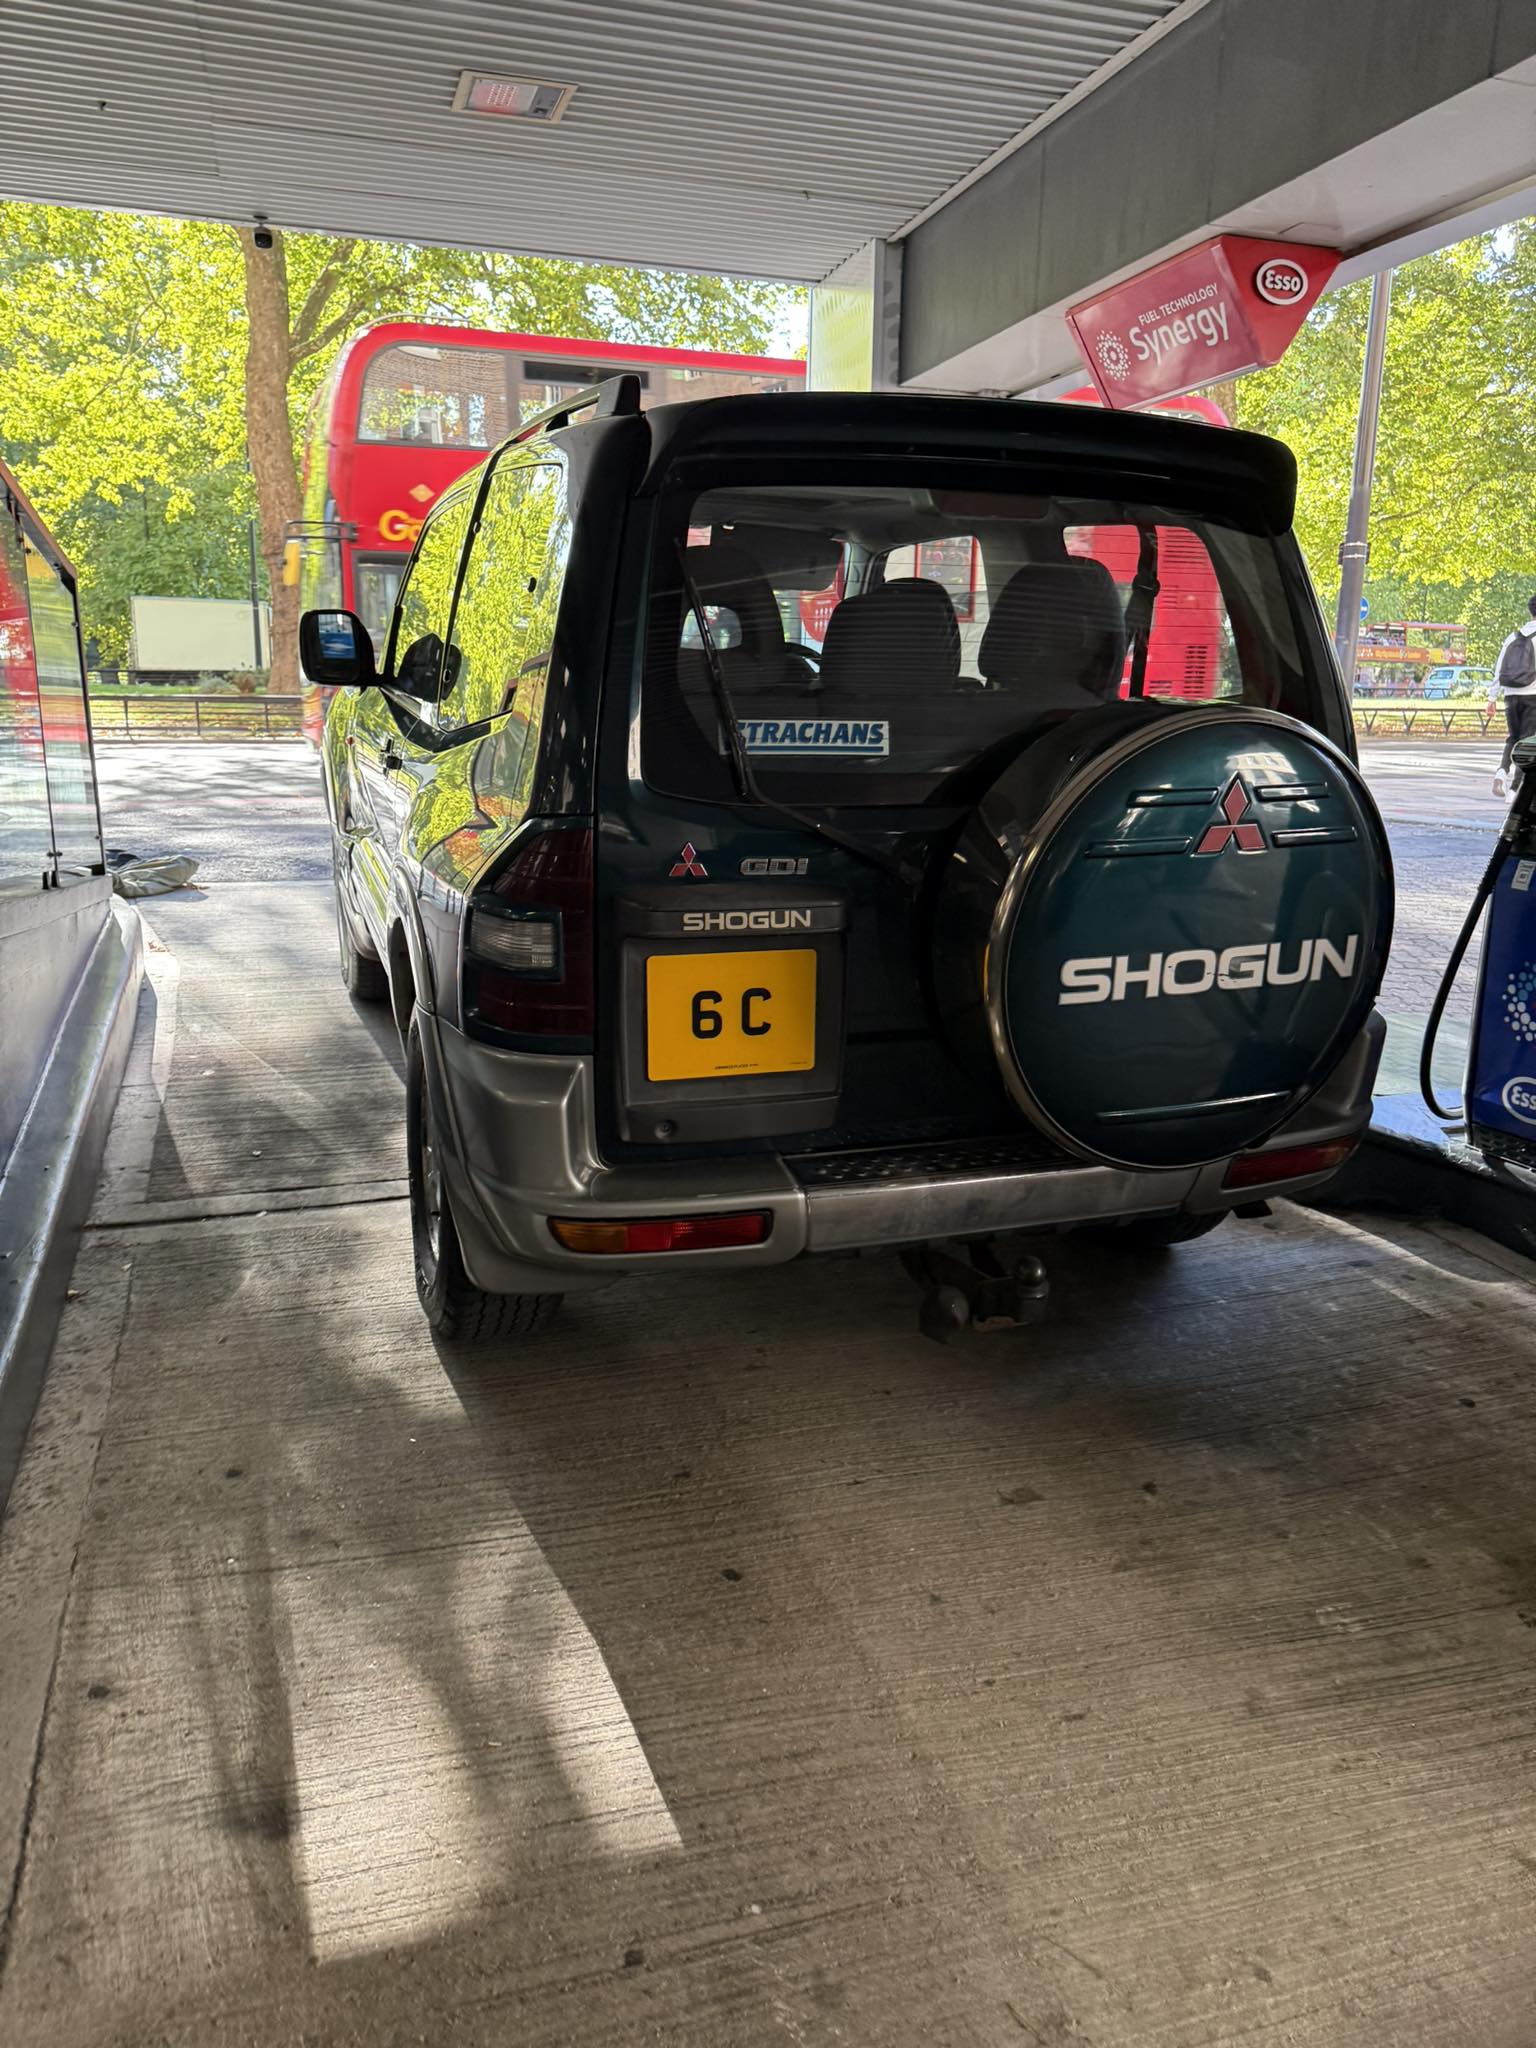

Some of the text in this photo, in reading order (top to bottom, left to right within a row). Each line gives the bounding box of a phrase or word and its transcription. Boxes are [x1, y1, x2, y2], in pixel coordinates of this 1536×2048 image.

[1264, 269, 1301, 293] Esso
[1138, 282, 1218, 326] FUEL TECHNOLOGY
[1129, 302, 1229, 366] Synergy
[683, 910, 811, 931] SHOGUN
[1058, 934, 1359, 1006] SHOGUN
[1511, 1085, 1536, 1110] Ess
